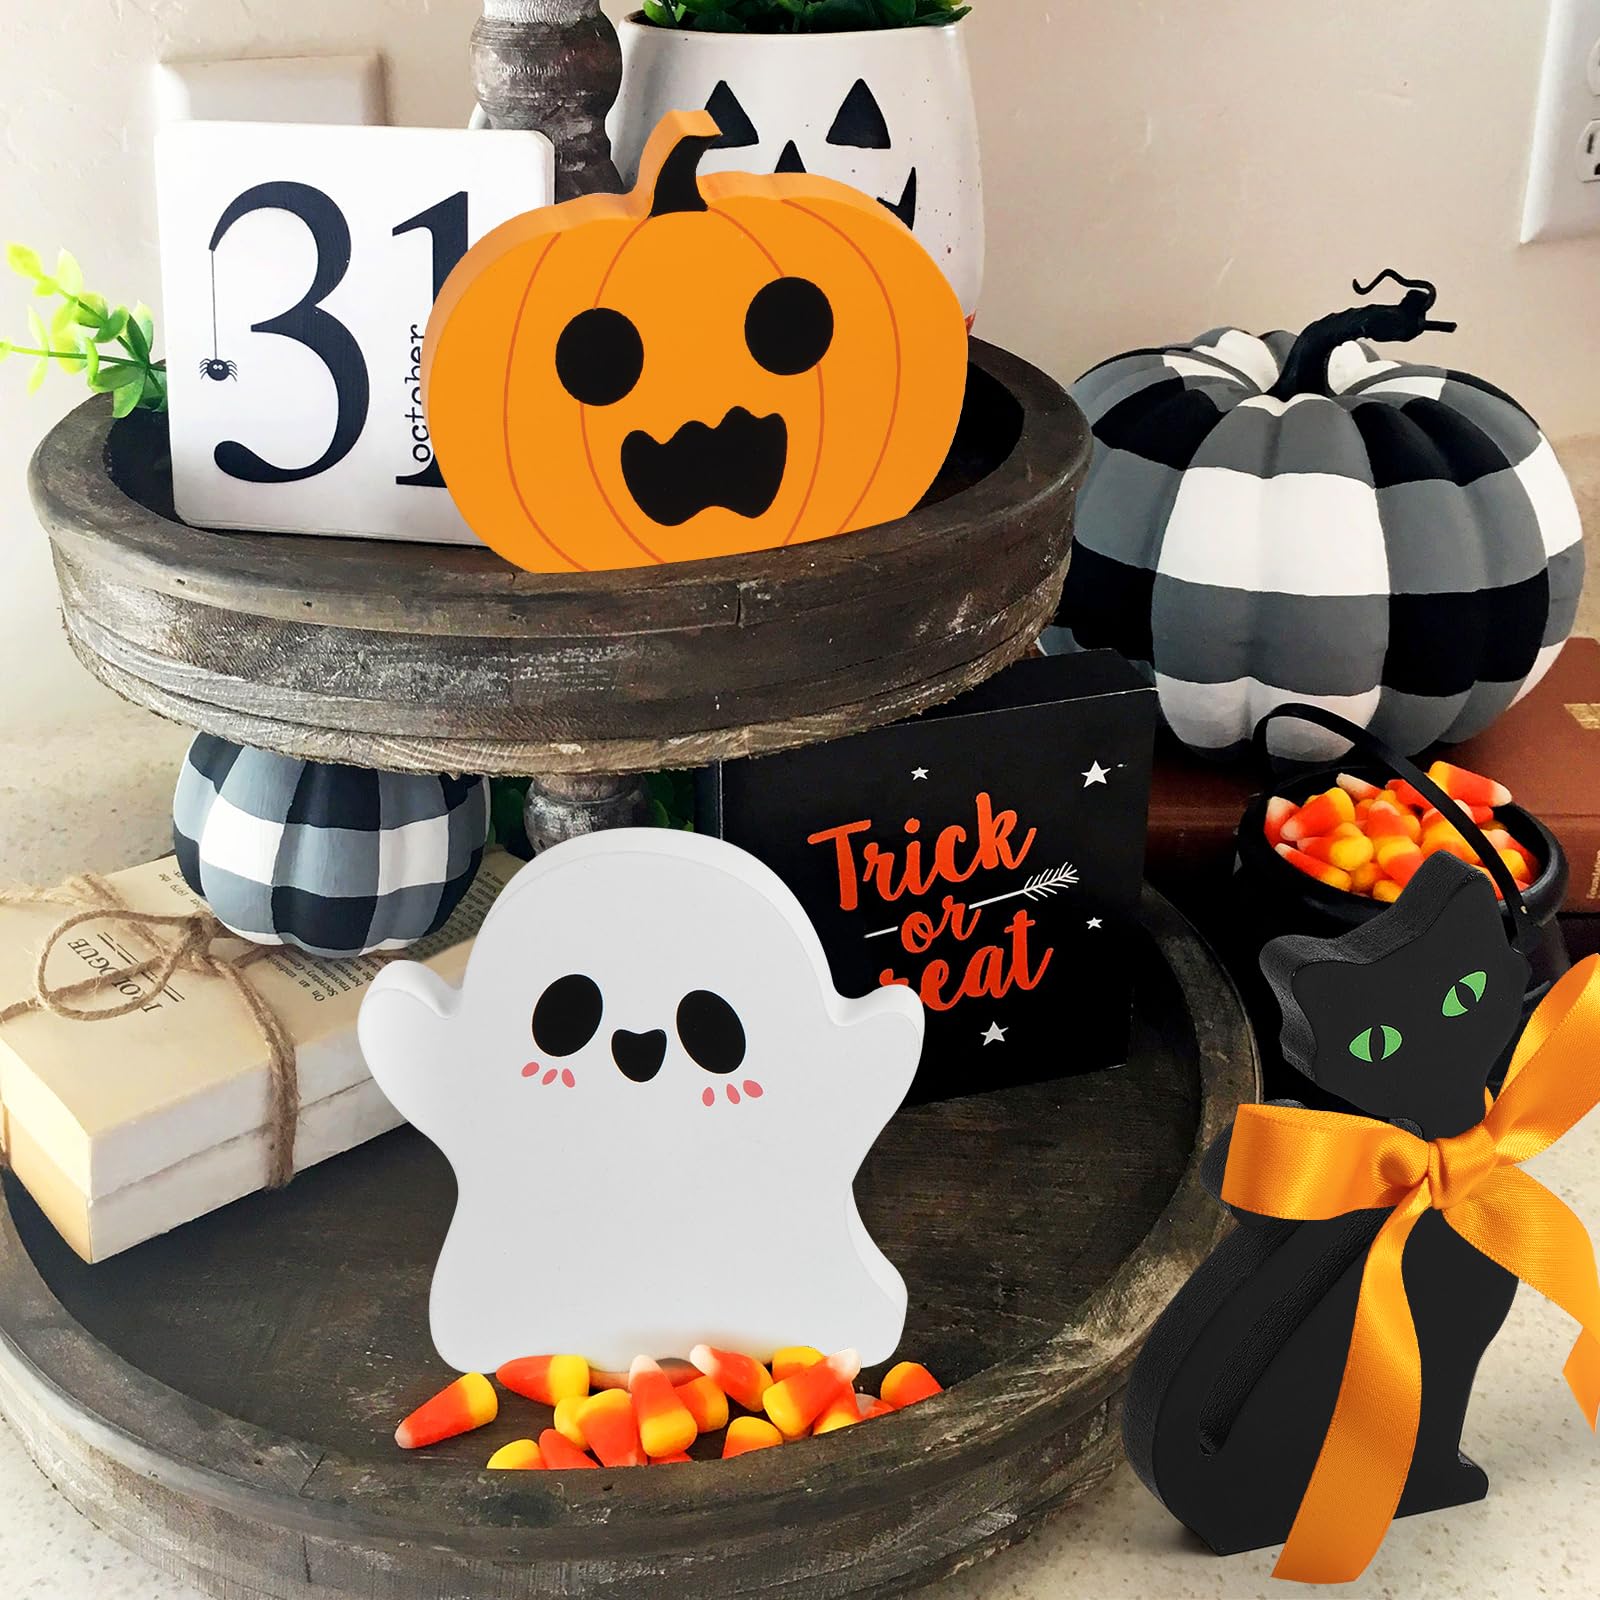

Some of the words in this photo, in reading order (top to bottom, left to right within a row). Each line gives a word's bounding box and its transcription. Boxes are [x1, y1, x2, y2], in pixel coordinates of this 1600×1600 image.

[208, 180, 469, 488] 31
[807, 791, 1037, 911] Trick
[901, 895, 981, 954] or
